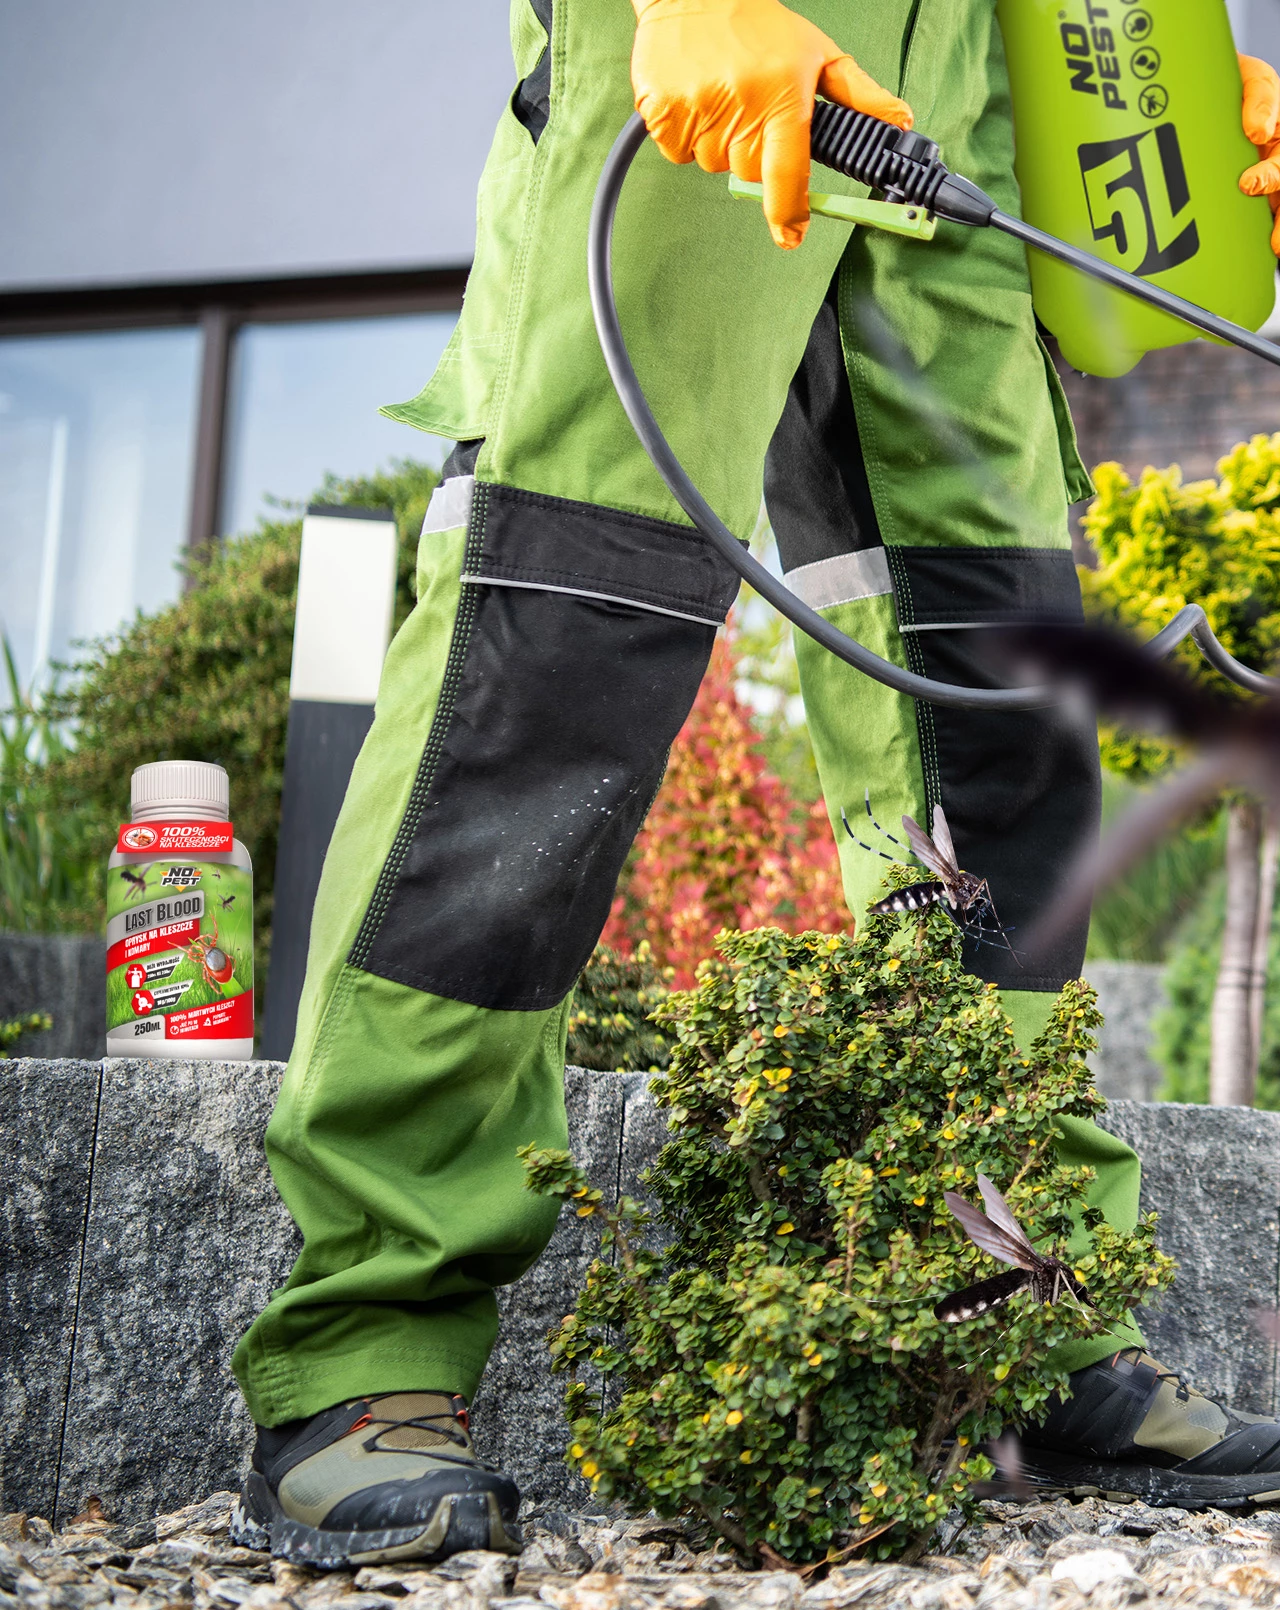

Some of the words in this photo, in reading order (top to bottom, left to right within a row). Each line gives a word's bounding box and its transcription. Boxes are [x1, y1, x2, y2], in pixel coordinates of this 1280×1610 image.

[1060, 22, 1099, 95] NO
[1085, 0, 1128, 110] PEST
[1083, 128, 1196, 275] 5L
[159, 835, 229, 844] SKUTECZNOŚCI
[161, 826, 206, 837] 100%
[168, 867, 194, 877] NO
[161, 877, 200, 886] PEST
[125, 908, 152, 932] LAST
[156, 897, 200, 922] BLOOD
[125, 932, 148, 948] OPRYSK
[149, 930, 158, 939] NA
[160, 920, 194, 937] KLESZCZE
[128, 942, 151, 958] KOMARY
[170, 1013, 187, 1023] 100%
